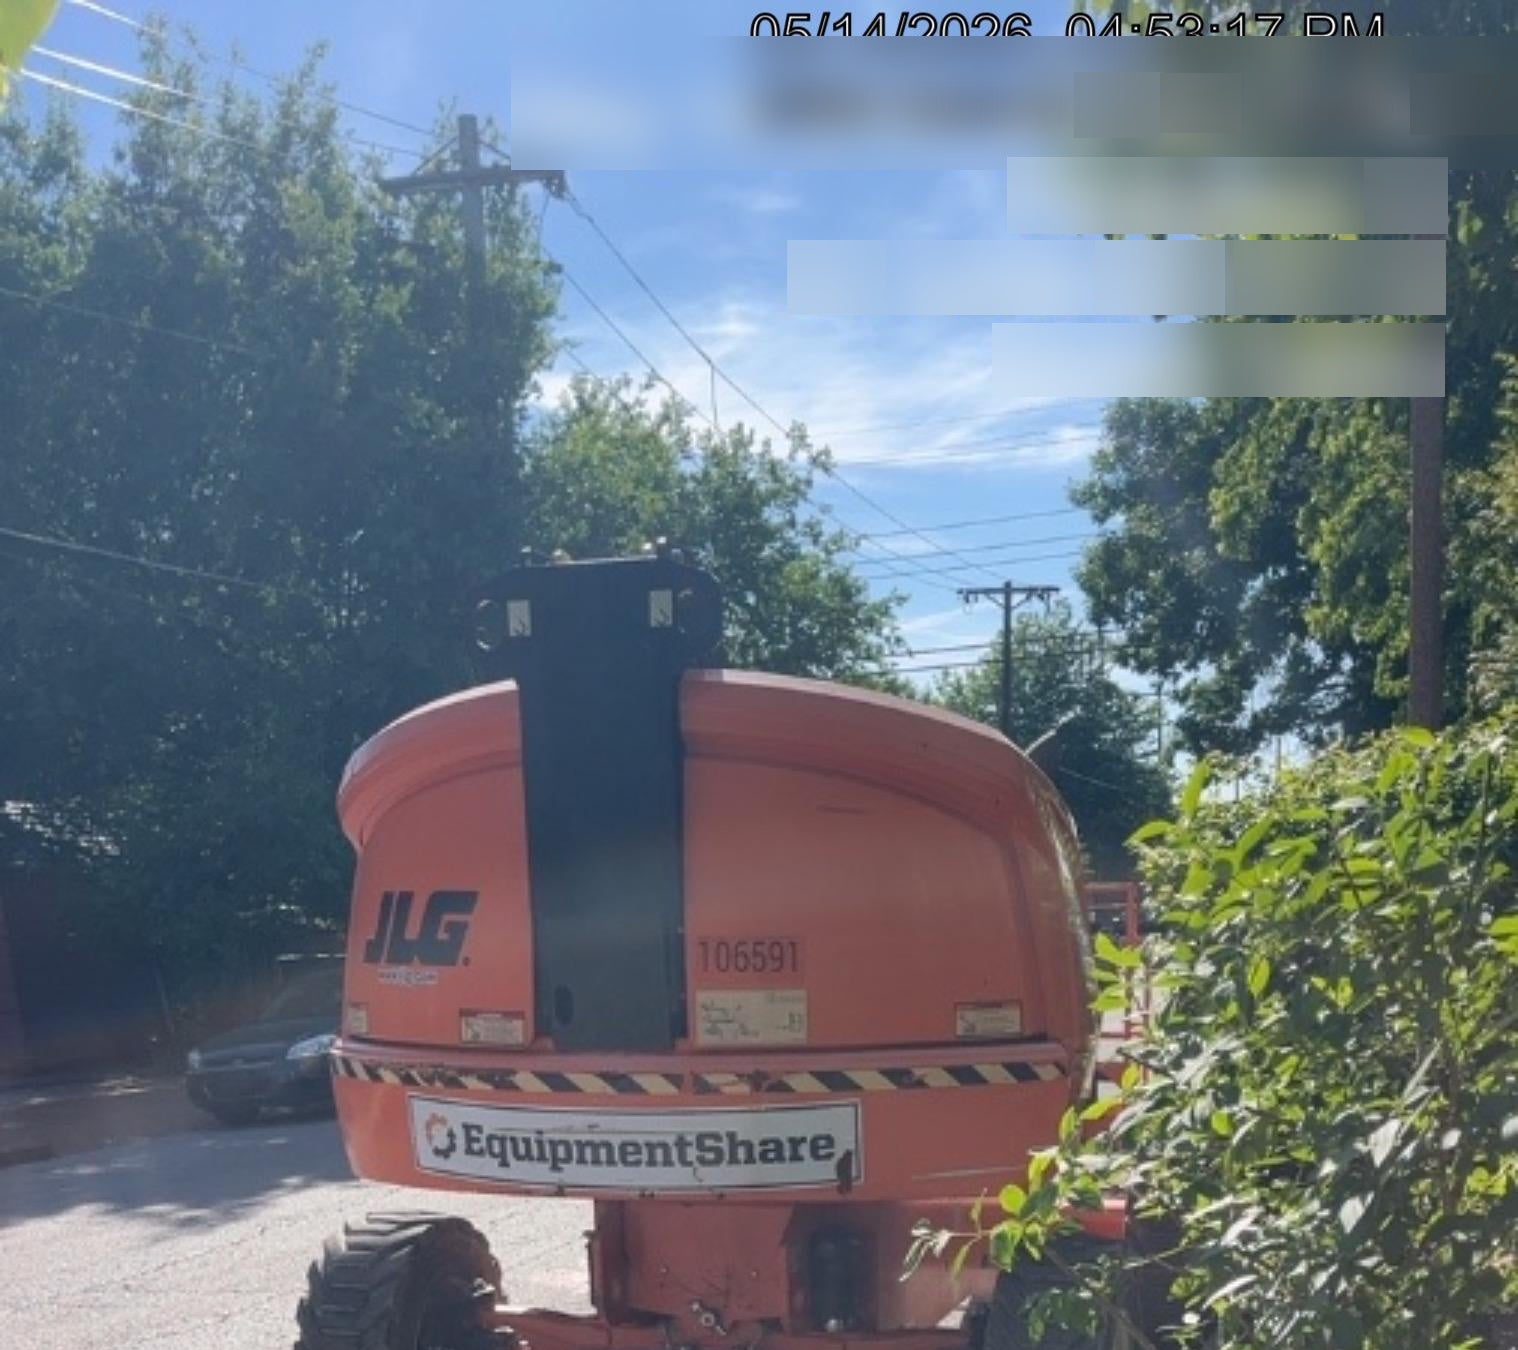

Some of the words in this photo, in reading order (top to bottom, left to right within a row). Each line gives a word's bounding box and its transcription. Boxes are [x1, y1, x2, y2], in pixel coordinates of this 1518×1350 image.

[363, 890, 480, 966] JLG
[699, 940, 800, 973] 106591
[461, 1122, 836, 1172] EquipmentShare
